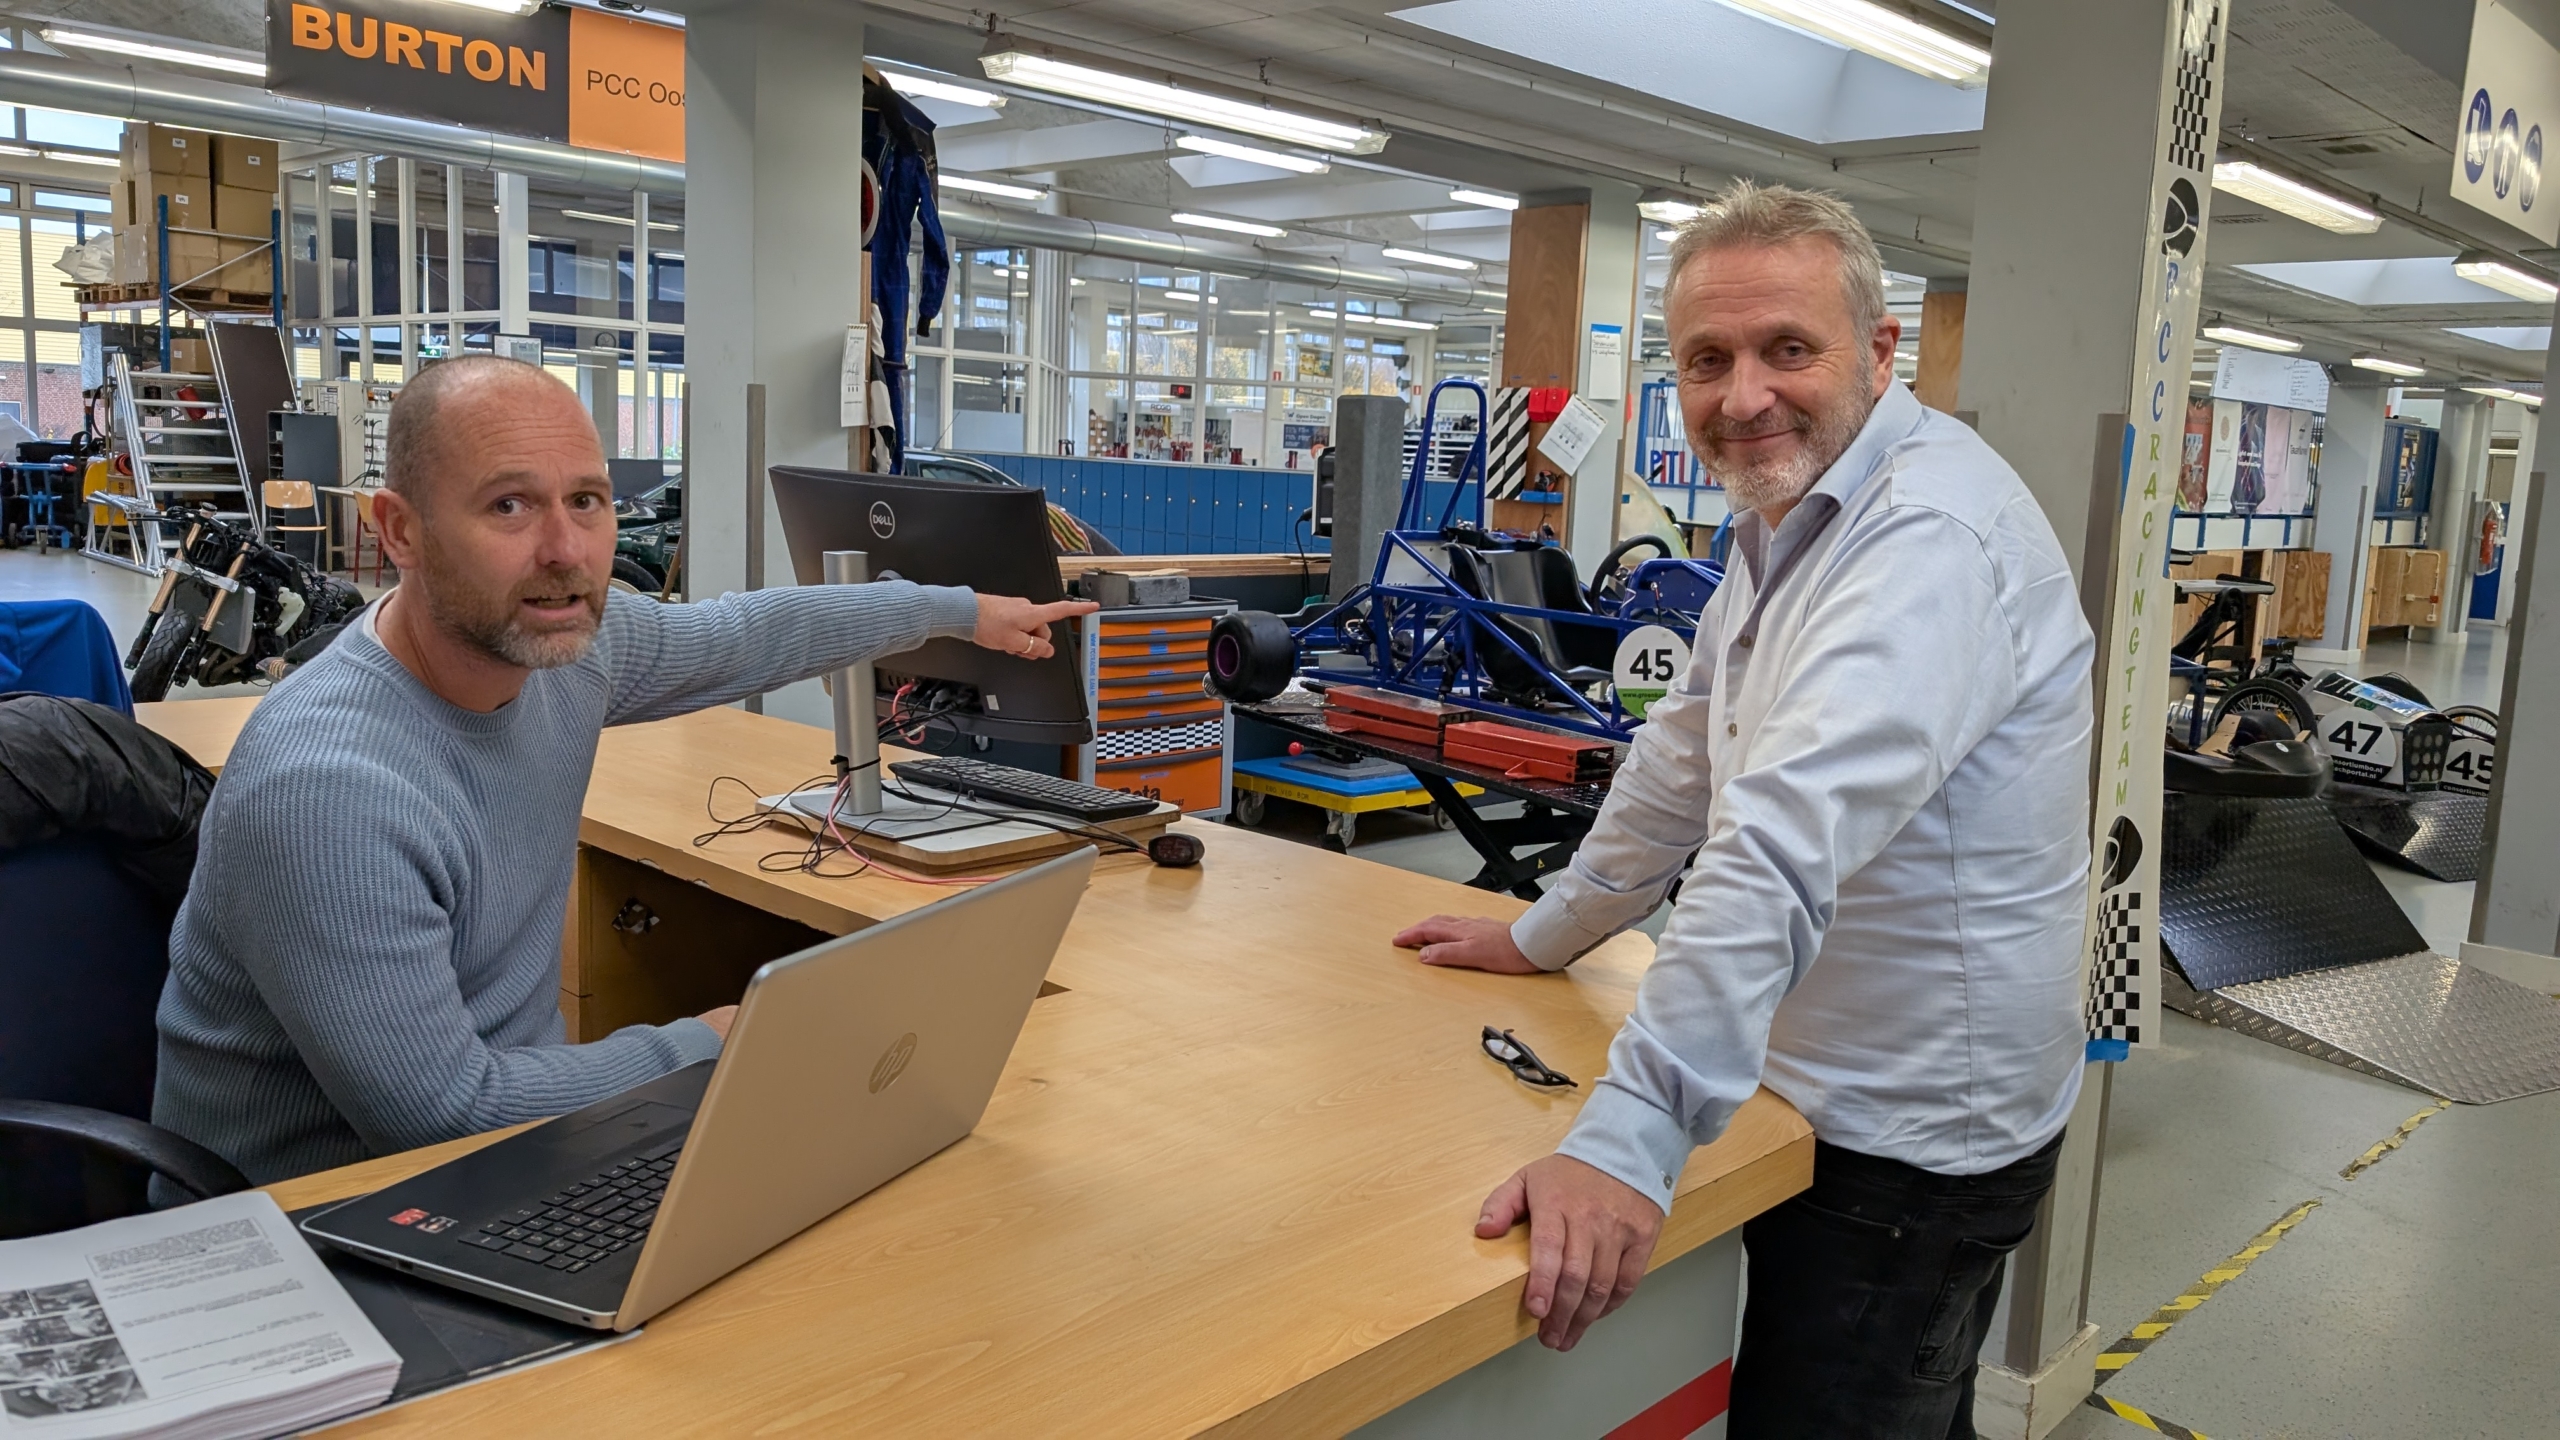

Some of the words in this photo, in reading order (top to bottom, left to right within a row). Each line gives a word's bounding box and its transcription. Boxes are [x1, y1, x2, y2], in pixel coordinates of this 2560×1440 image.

[291, 3, 546, 91] BURTON
[587, 69, 641, 99] PCC
[872, 514, 893, 526] DELL
[1629, 648, 1674, 682] 45
[2328, 720, 2383, 755] 47
[2333, 759, 2383, 774] nsortiumbo.nl
[2334, 766, 2377, 779] echportal.nl
[2446, 751, 2494, 785] 45
[2443, 784, 2488, 797] consortiumb
